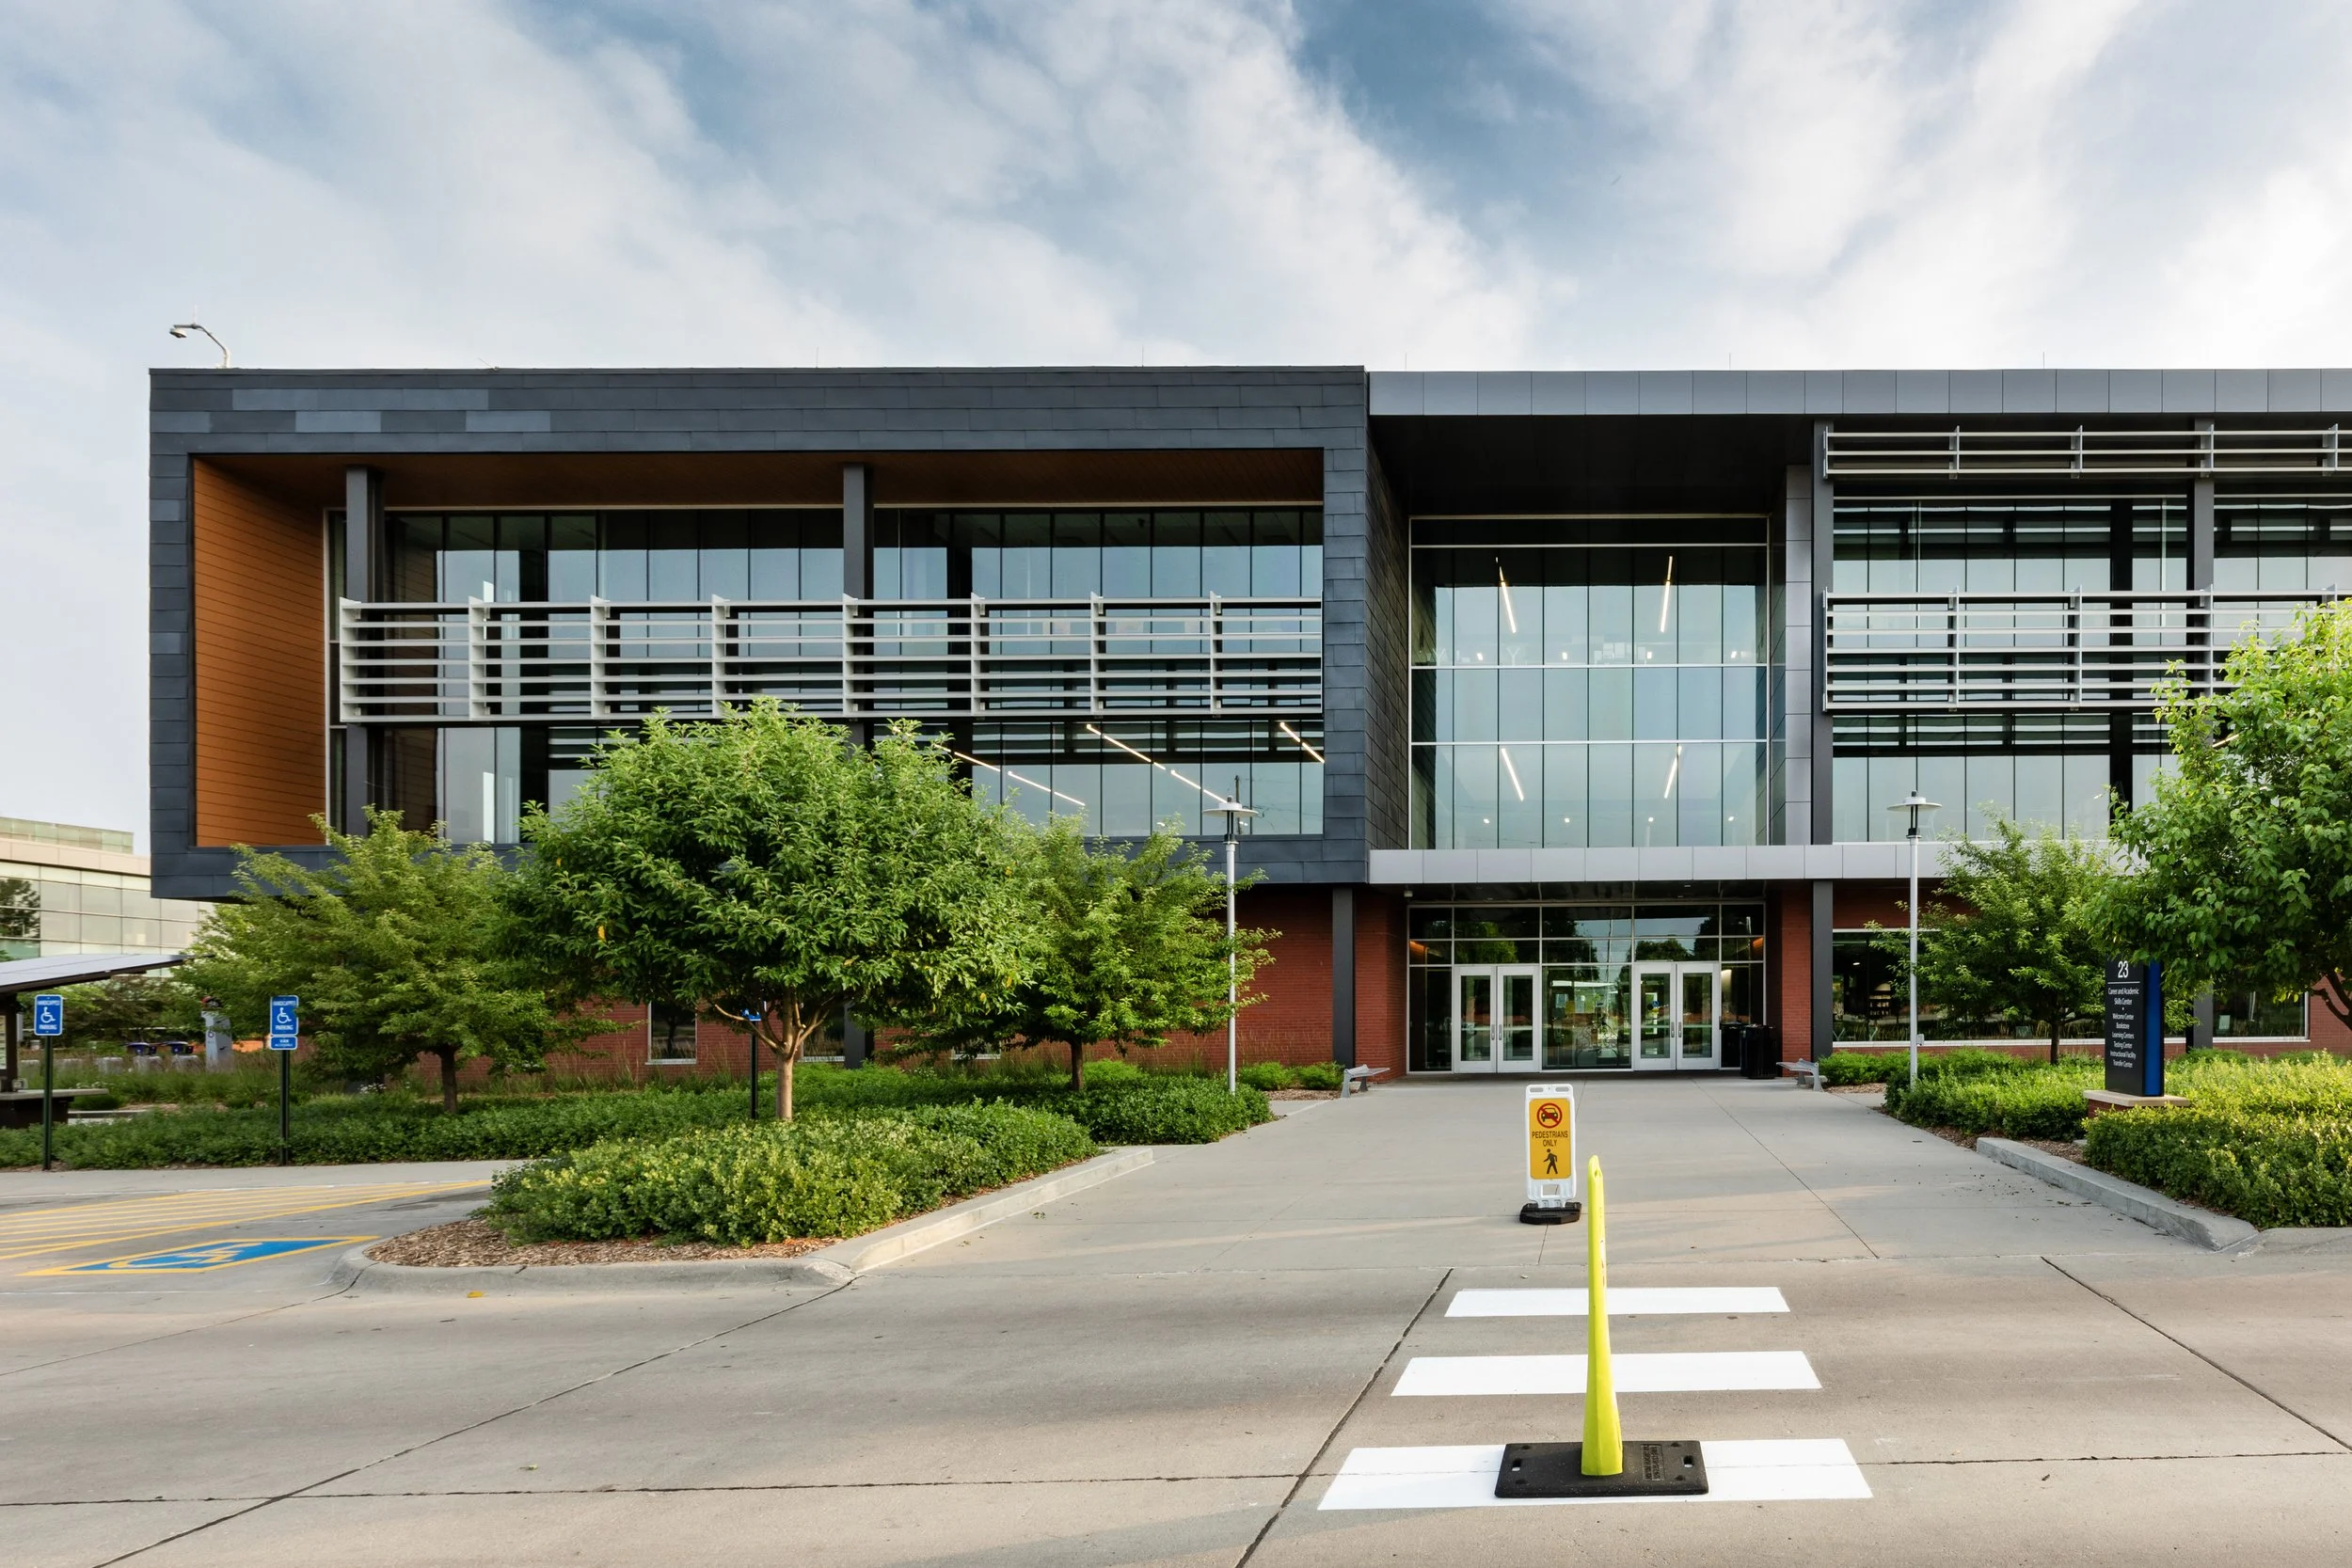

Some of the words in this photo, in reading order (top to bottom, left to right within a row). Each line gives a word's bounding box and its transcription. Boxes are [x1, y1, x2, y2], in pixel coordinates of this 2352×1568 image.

[2118, 960, 2129, 978] 23
[2112, 1031, 2123, 1039] Learning
[2113, 1040, 2123, 1050] Testing
[2109, 1050, 2125, 1058] Instructional
[2125, 1051, 2137, 1060] Facility
[2123, 1060, 2133, 1069] Center
[1532, 1131, 1568, 1139] PEDESTRIANS
[1543, 1139, 1557, 1148] ONLY
